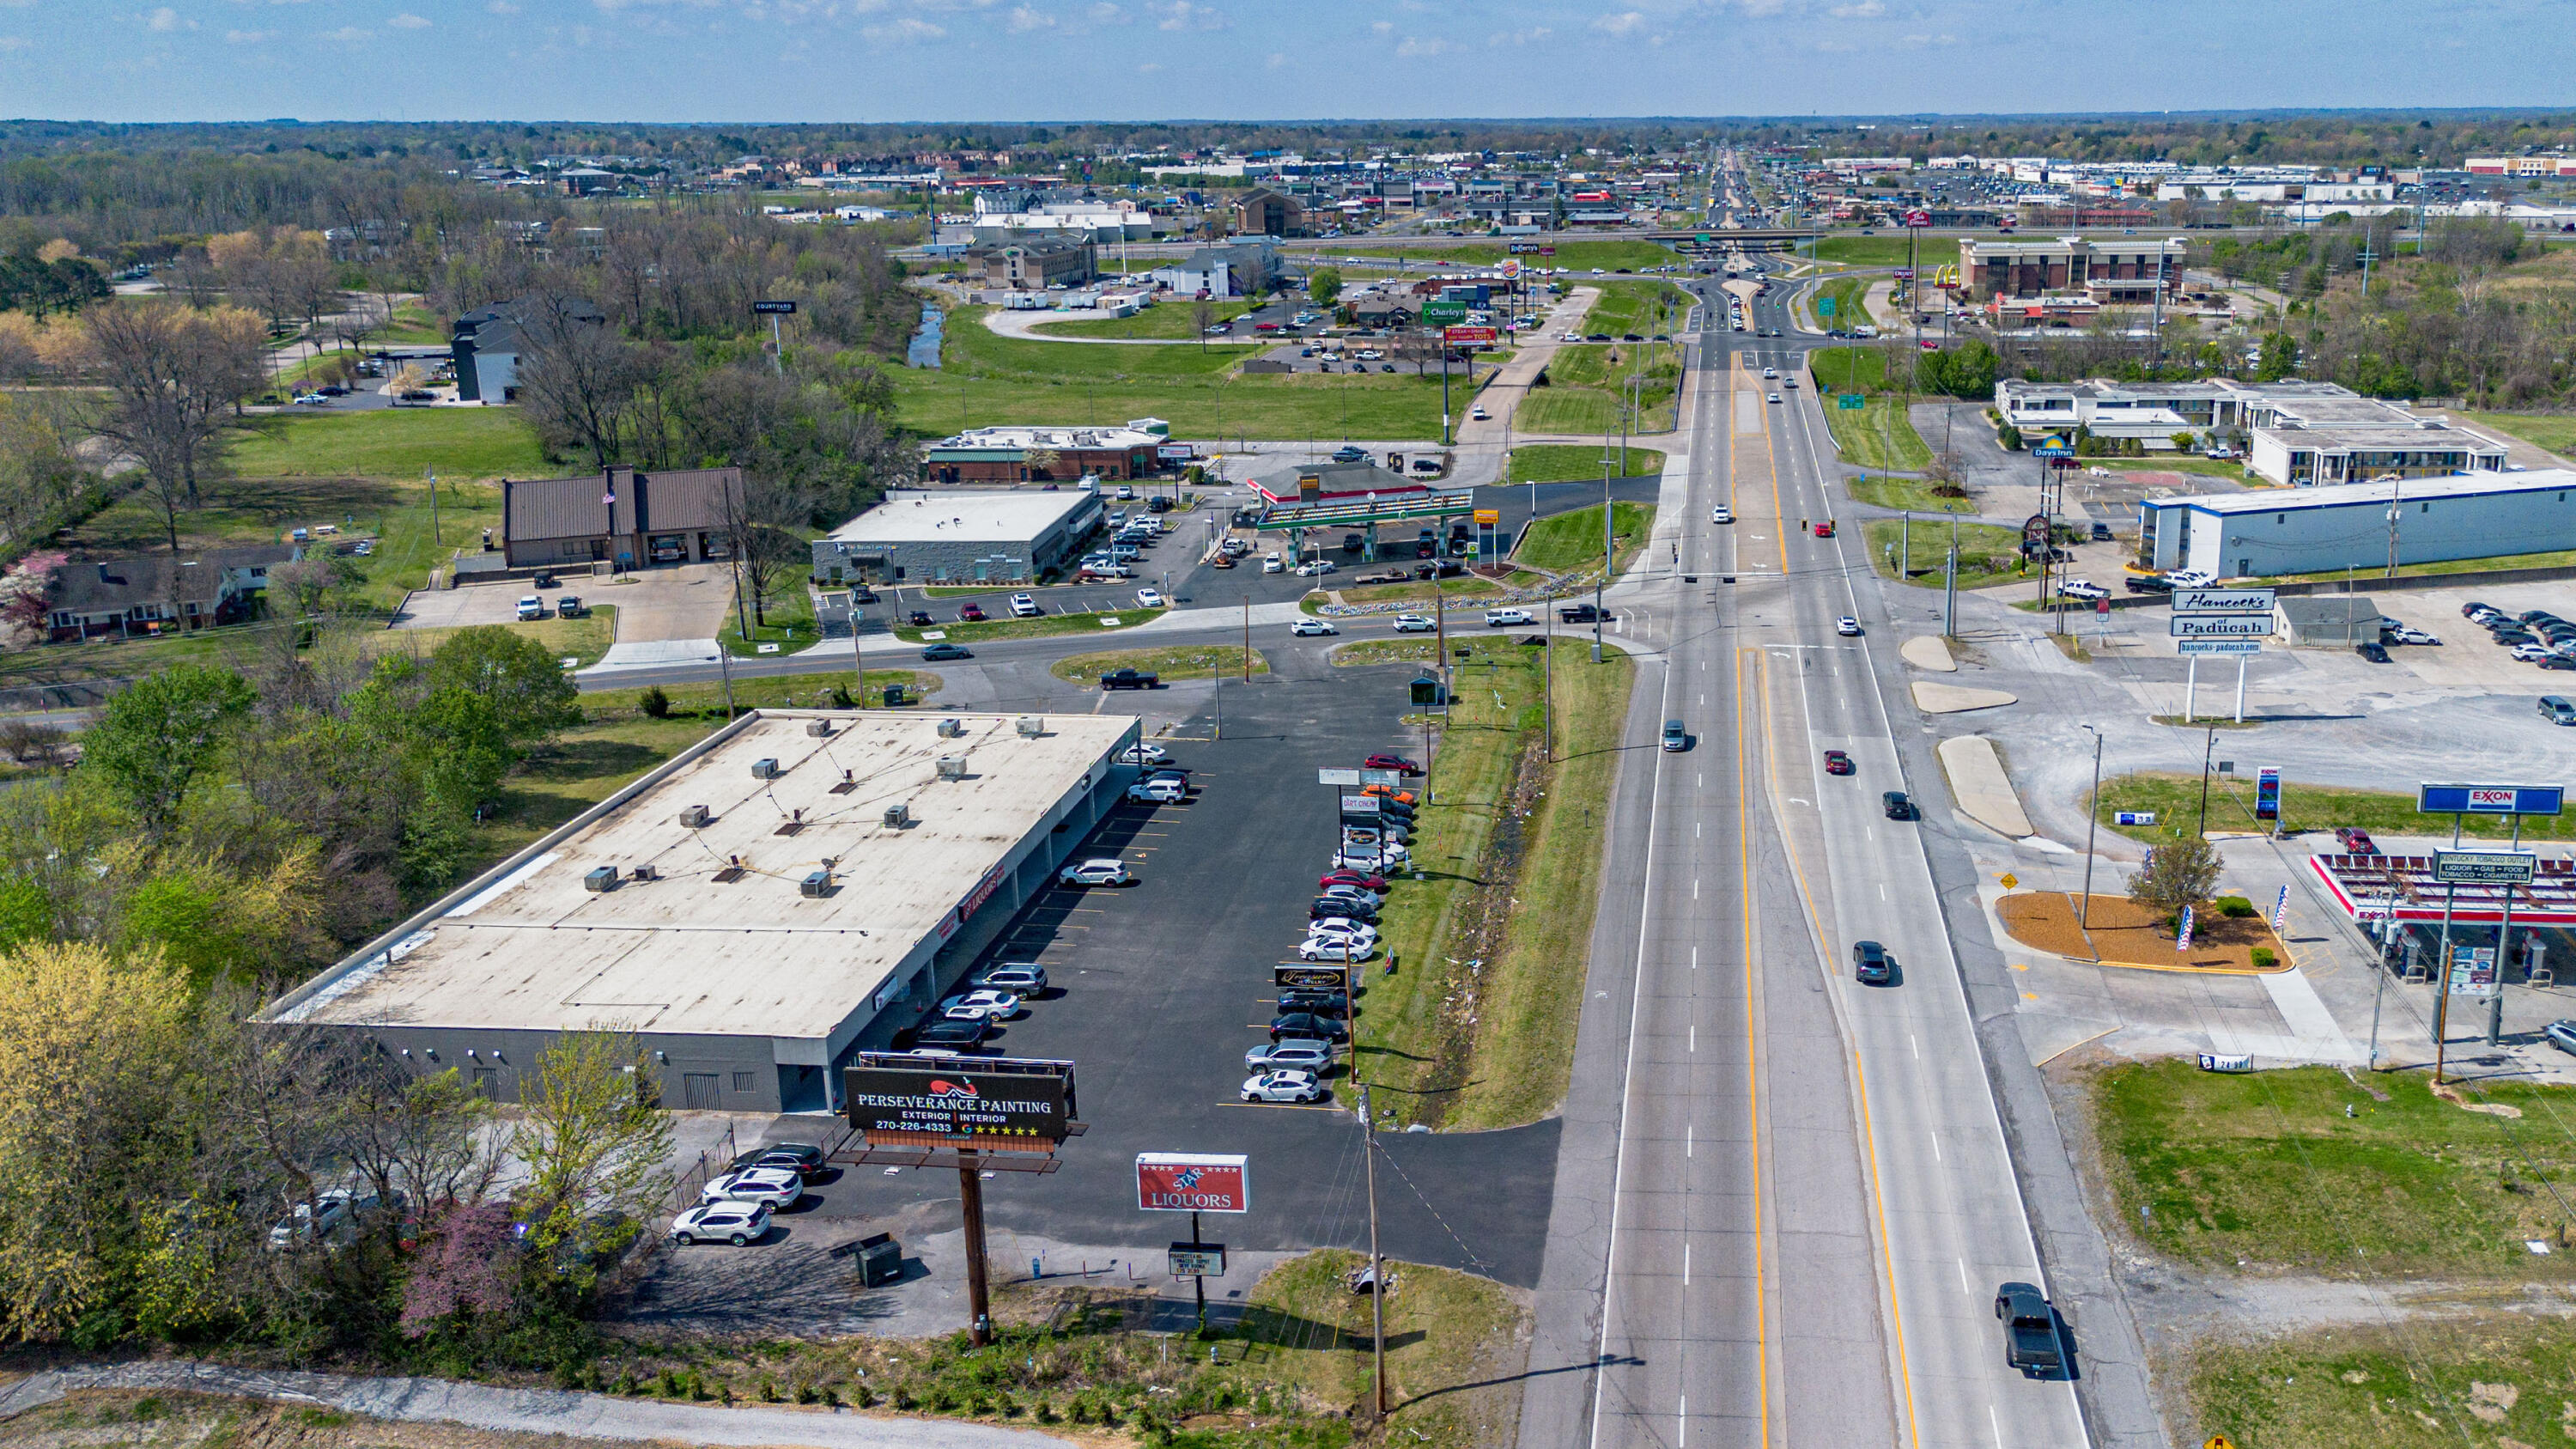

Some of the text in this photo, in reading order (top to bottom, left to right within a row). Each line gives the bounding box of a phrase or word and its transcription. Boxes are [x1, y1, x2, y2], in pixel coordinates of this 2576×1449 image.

[2184, 593, 2265, 609] Hancock's
[2181, 622, 2263, 634] Paducah
[2181, 643, 2259, 653] hancocks-paducah.com
[1343, 799, 1358, 807] DIRT
[2472, 789, 2512, 804] EXXON
[972, 880, 996, 910] LIQUORS
[859, 1094, 1052, 1114] PERSEVERANCE PAINTING
[902, 1111, 1006, 1123] EXTERIOR INTERIOR
[876, 1121, 952, 1133] 270-226-4333
[1173, 1167, 1206, 1192] STAR
[1151, 1192, 1231, 1209] LIQUORS
